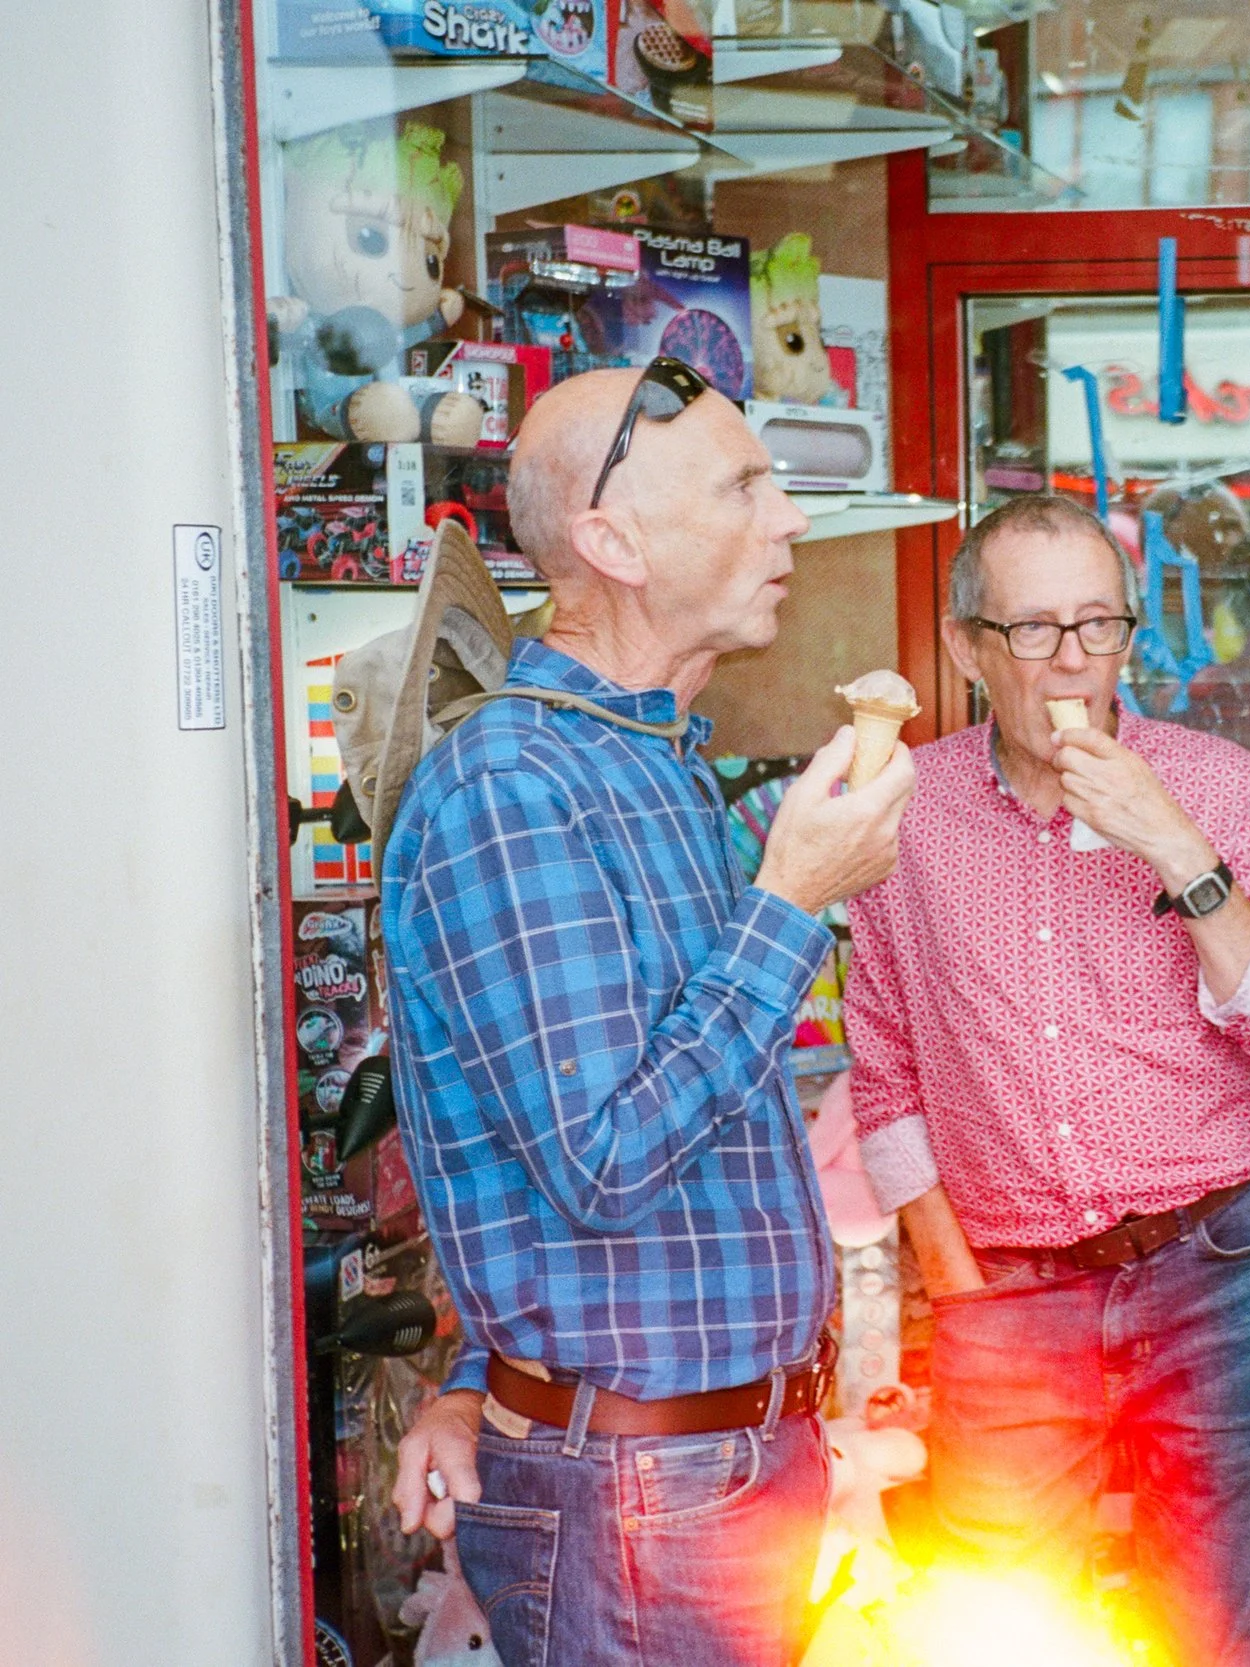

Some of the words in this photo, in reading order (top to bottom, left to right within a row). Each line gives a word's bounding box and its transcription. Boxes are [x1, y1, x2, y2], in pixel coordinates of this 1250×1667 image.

[423, 0, 529, 54] Shark
[633, 229, 704, 254] Plasma
[707, 238, 741, 258] Ball
[661, 250, 715, 272] Lamp
[201, 541, 211, 563] UK
[302, 962, 344, 989] DINO
